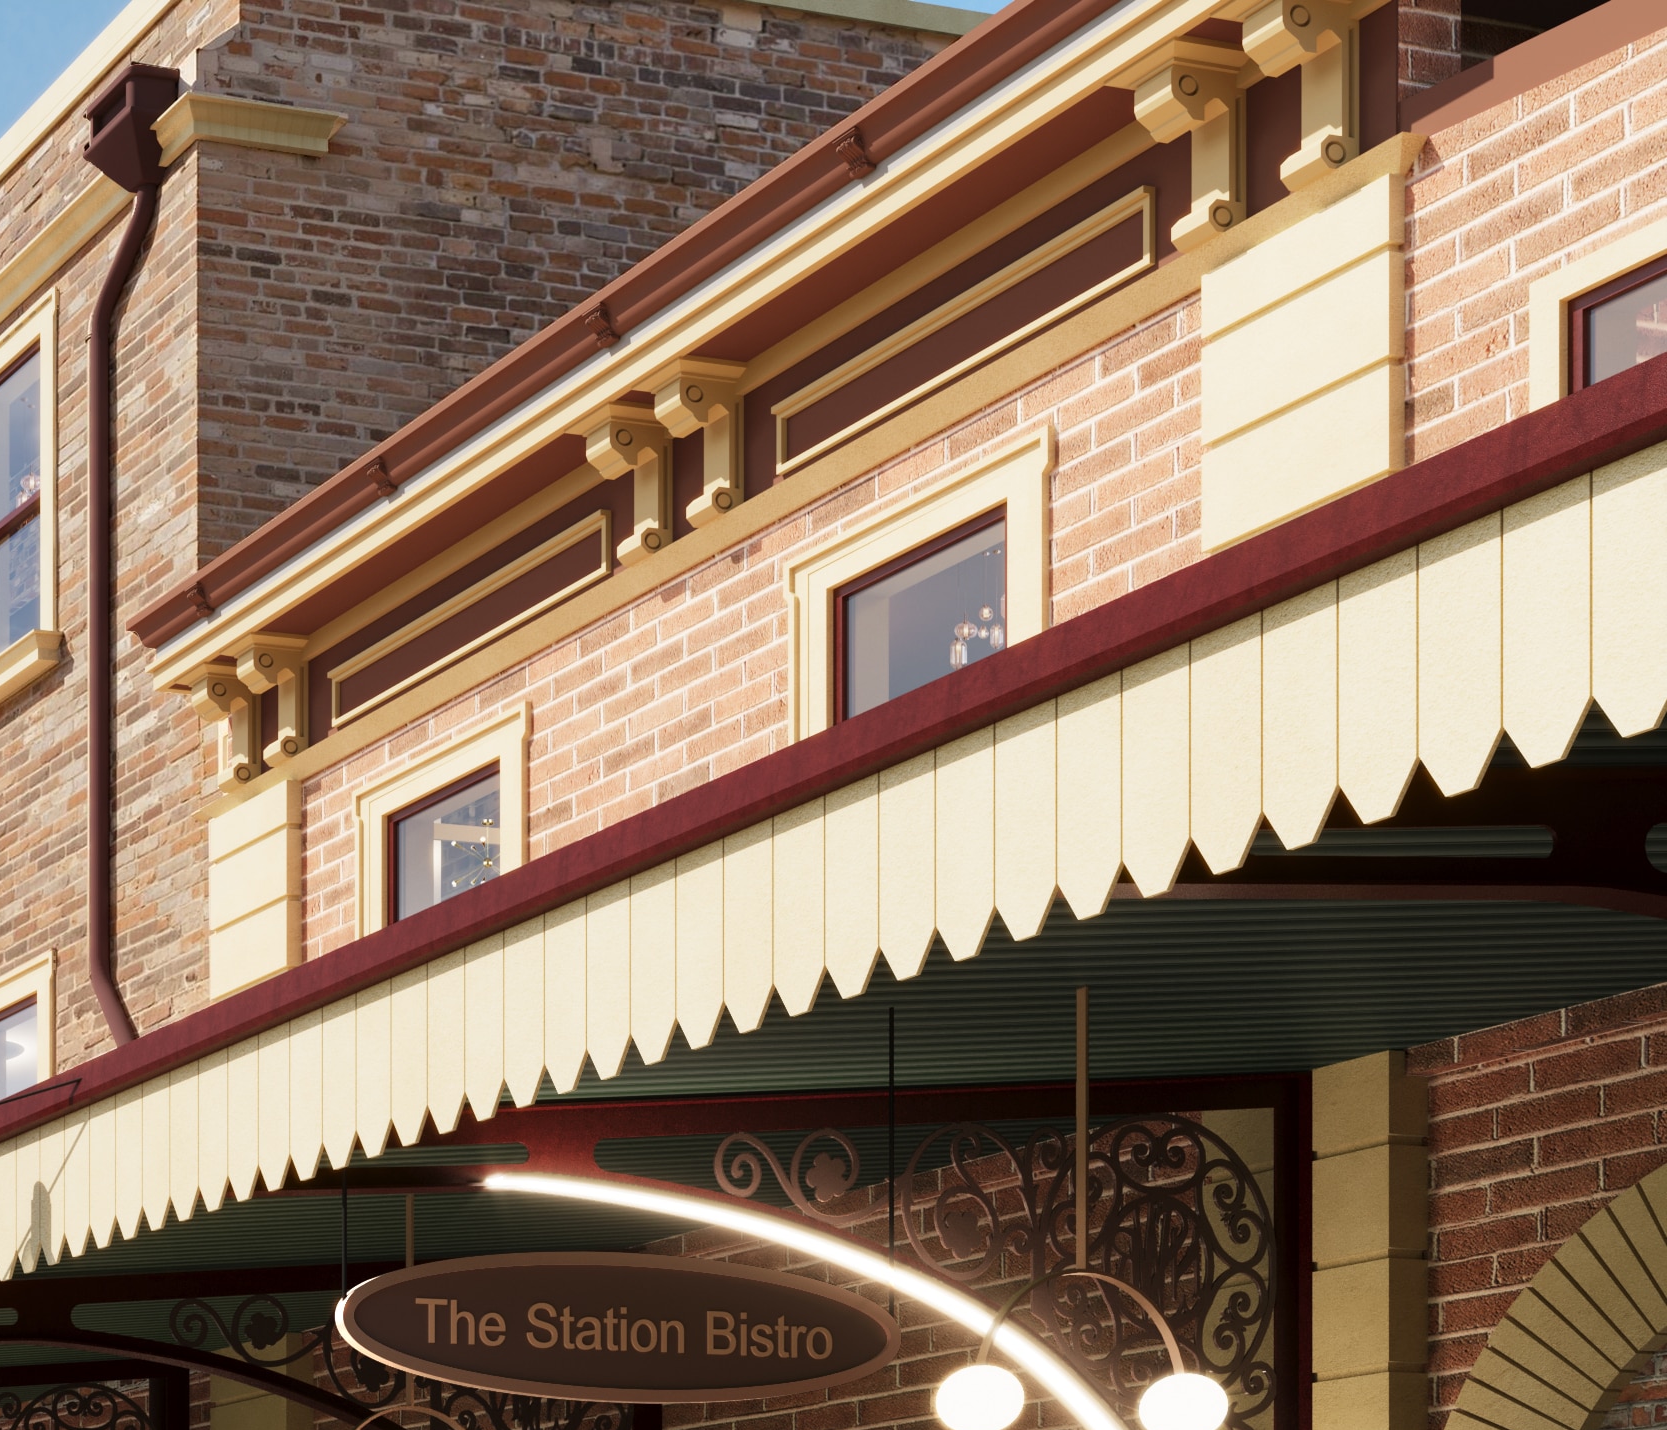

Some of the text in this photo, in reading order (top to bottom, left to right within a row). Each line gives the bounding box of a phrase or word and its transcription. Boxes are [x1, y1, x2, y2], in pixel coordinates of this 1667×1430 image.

[415, 1297, 834, 1361] The Station Bistro
